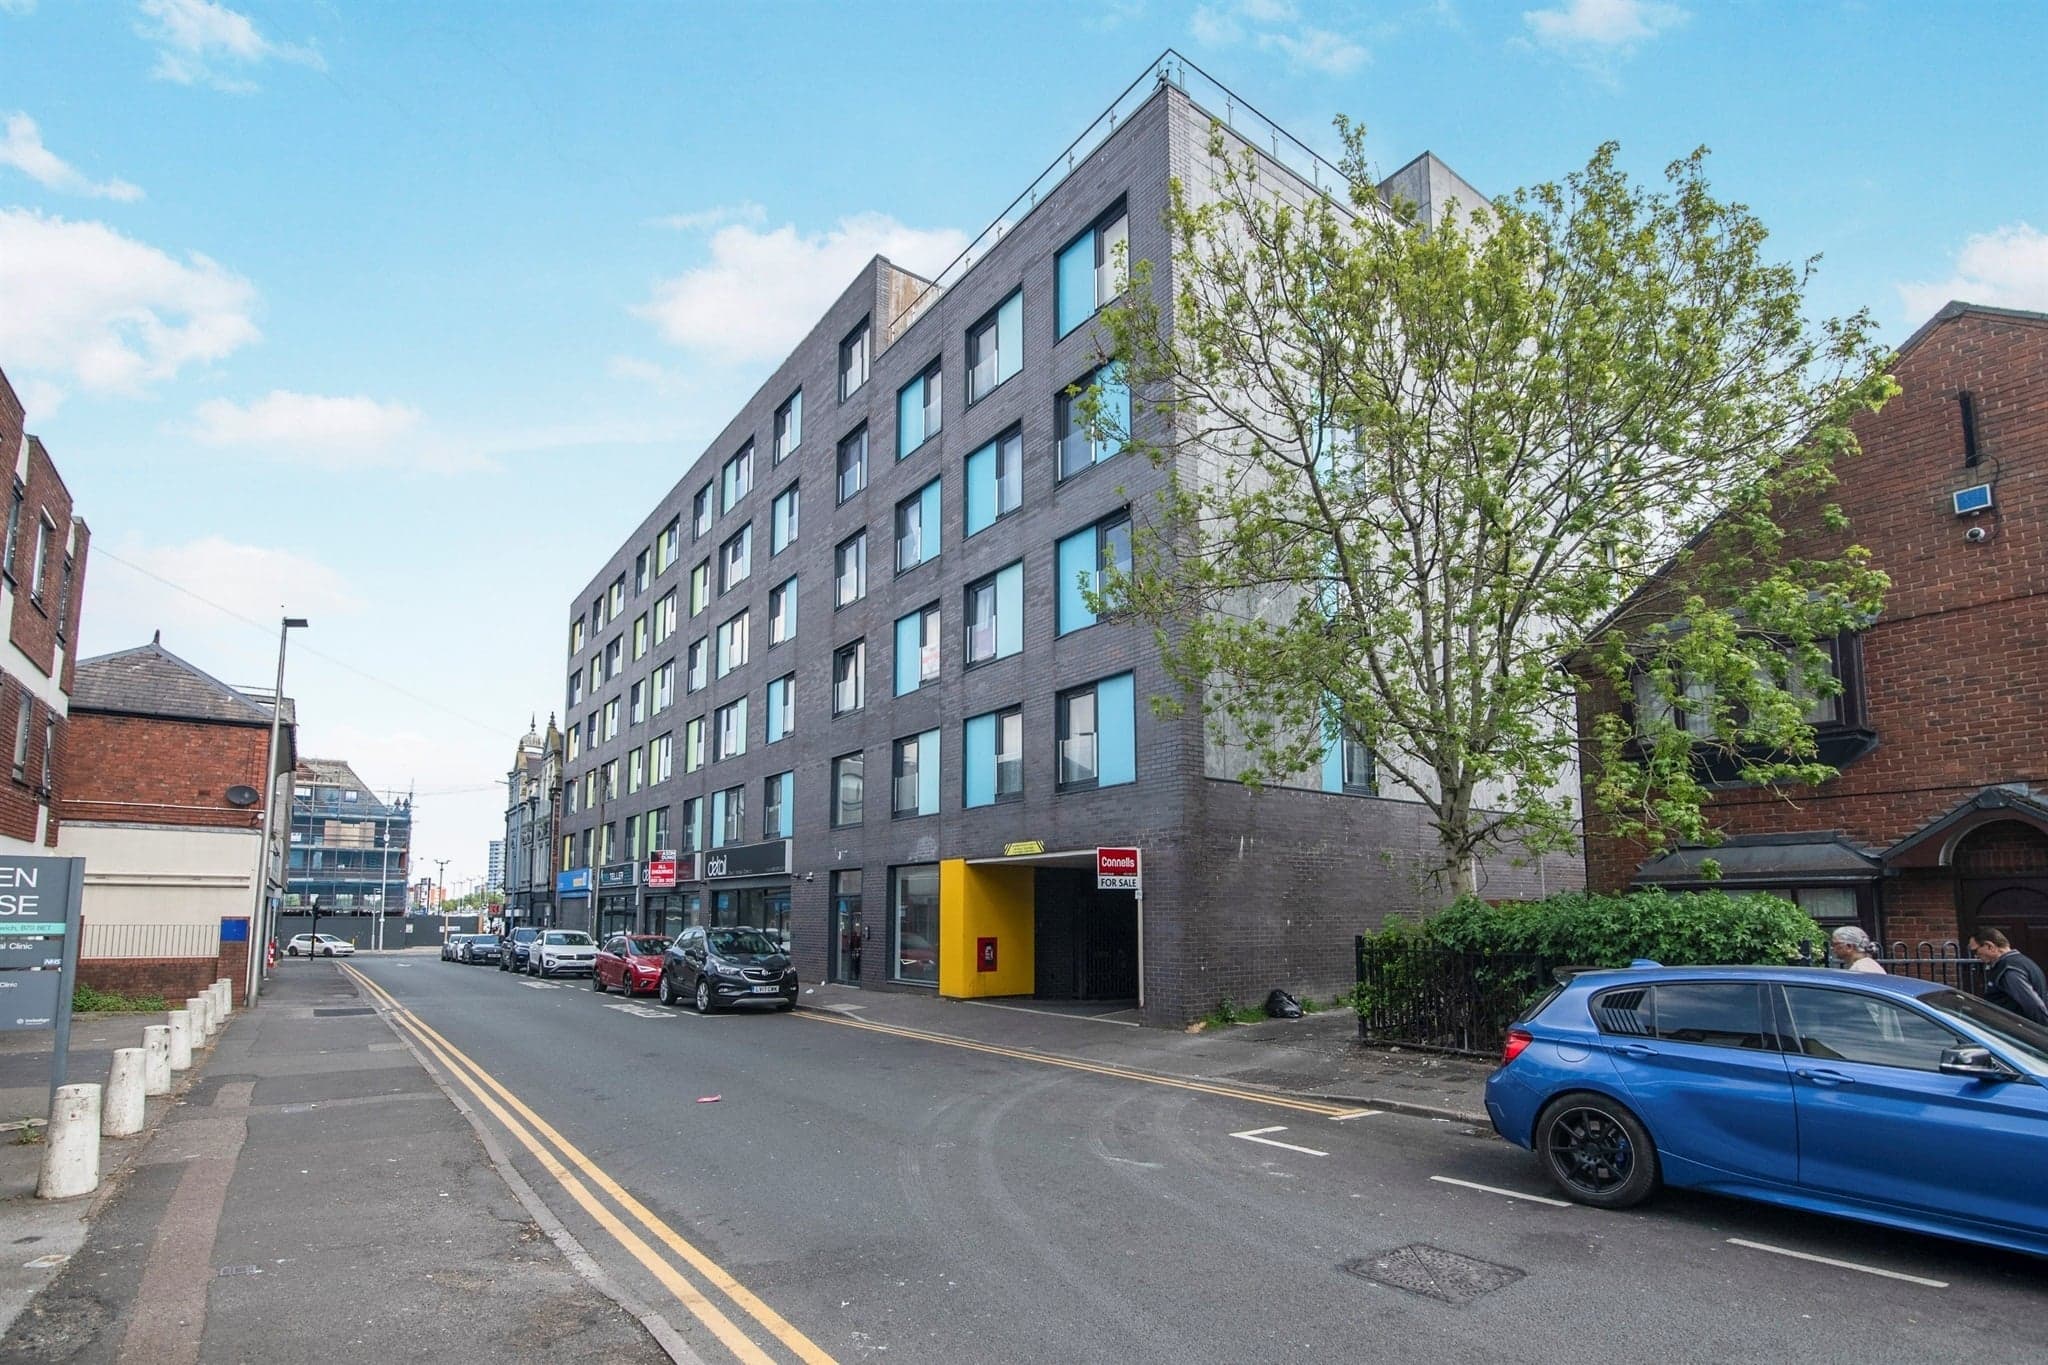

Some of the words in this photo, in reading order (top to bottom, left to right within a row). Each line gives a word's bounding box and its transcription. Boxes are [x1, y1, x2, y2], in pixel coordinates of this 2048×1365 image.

[1101, 856, 1135, 868] Connells
[1101, 878, 1117, 888] FOR
[1119, 878, 1137, 888] SALE
[9, 942, 33, 950] Clinic
